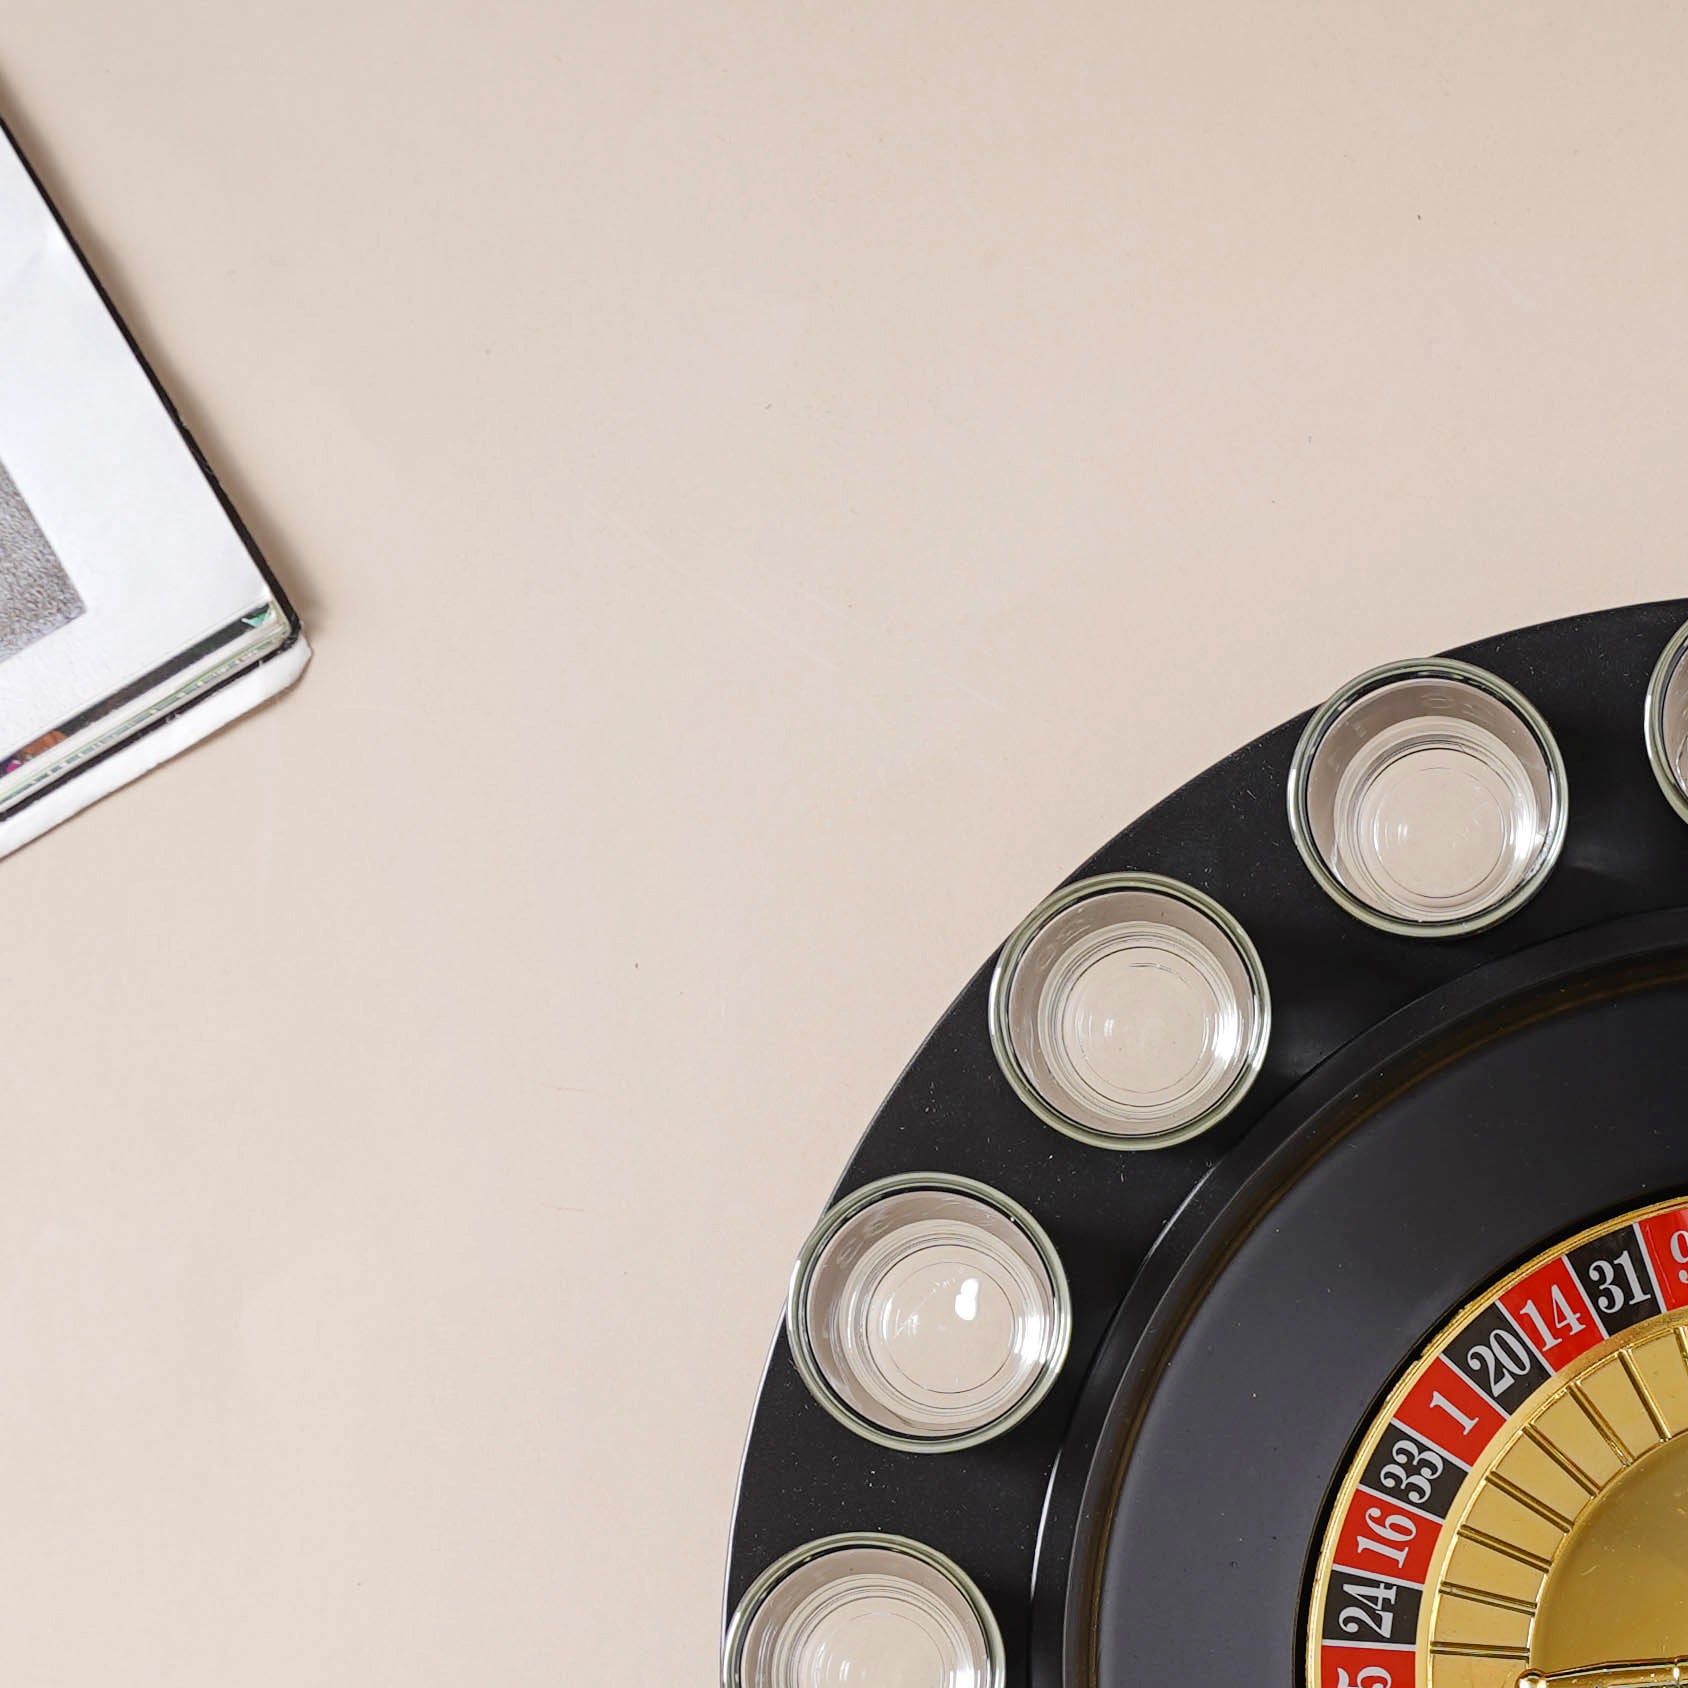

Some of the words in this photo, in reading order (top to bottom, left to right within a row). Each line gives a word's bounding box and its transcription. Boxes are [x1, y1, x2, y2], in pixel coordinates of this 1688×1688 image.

[1589, 1250, 1651, 1314] 31
[1519, 1284, 1586, 1352] 14
[1467, 1329, 1531, 1398] 20
[1429, 1391, 1479, 1435] 1
[1380, 1439, 1444, 1504] 33
[1356, 1507, 1417, 1569] 16
[1338, 1582, 1397, 1639] 24
